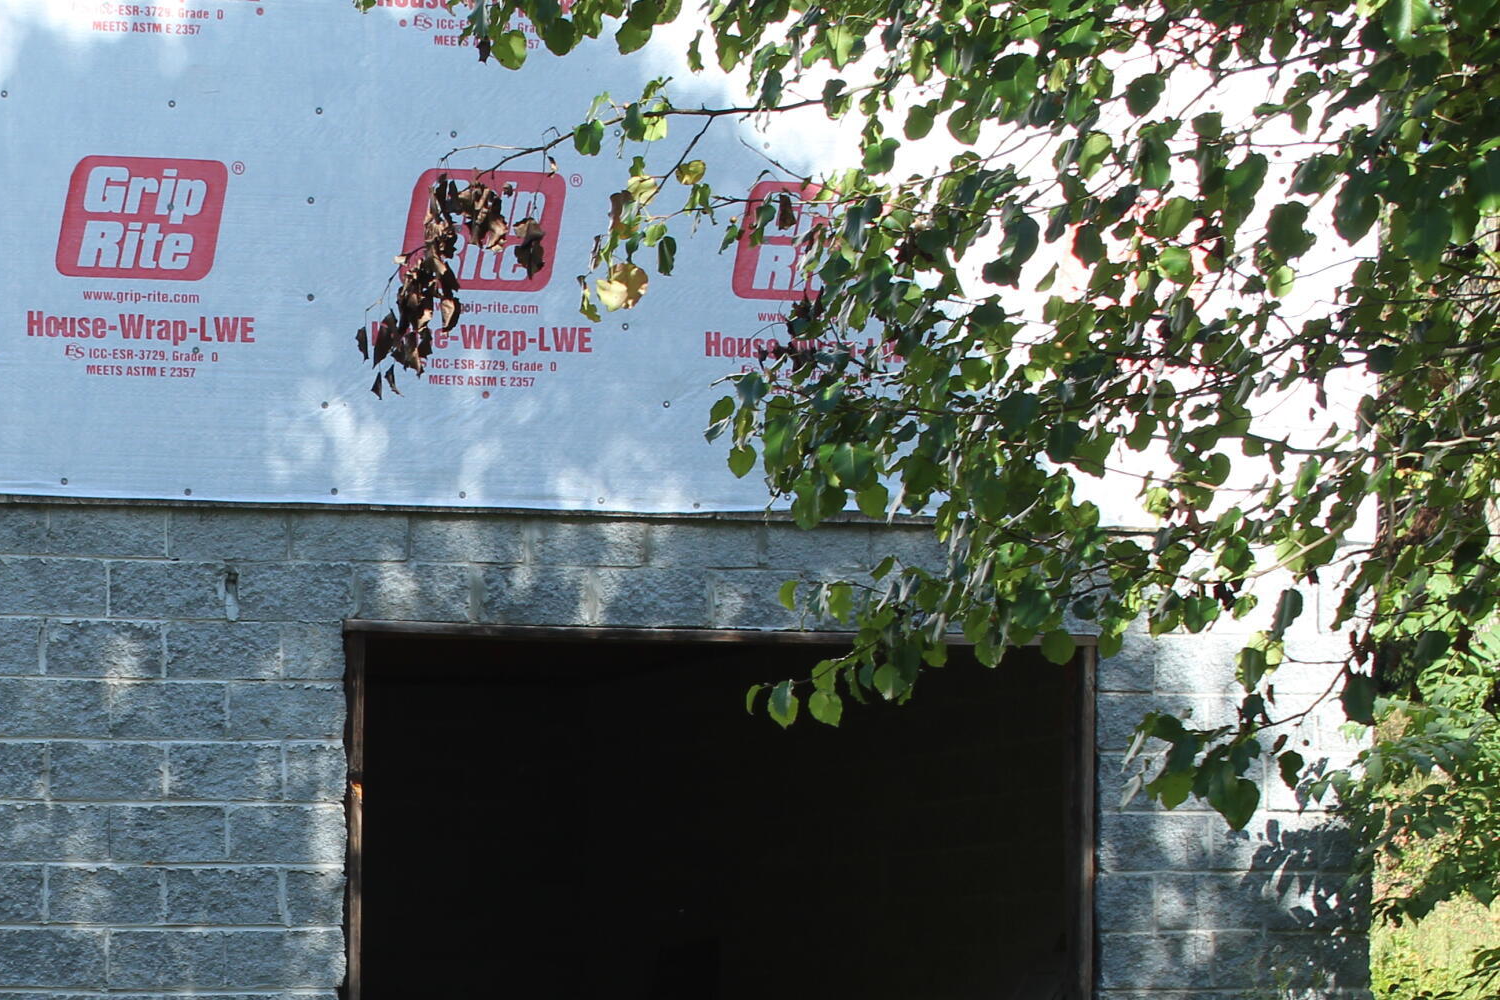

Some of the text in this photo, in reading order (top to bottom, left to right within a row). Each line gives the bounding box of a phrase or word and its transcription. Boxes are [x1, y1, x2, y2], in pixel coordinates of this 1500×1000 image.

[178, 8, 209, 20] Grade
[92, 20, 201, 35] MEETS ASTM E 2357
[83, 165, 208, 224] Grip
[76, 220, 194, 270] Rite
[82, 290, 200, 304] www.grip-rite.com
[26, 310, 256, 346] House-Wrap-LWE
[172, 350, 204, 362] Grade
[86, 364, 196, 378] MEETS ASTM E 2357
[512, 360, 543, 372] Grade
[428, 374, 536, 387] MEETS ASTM E 2357
